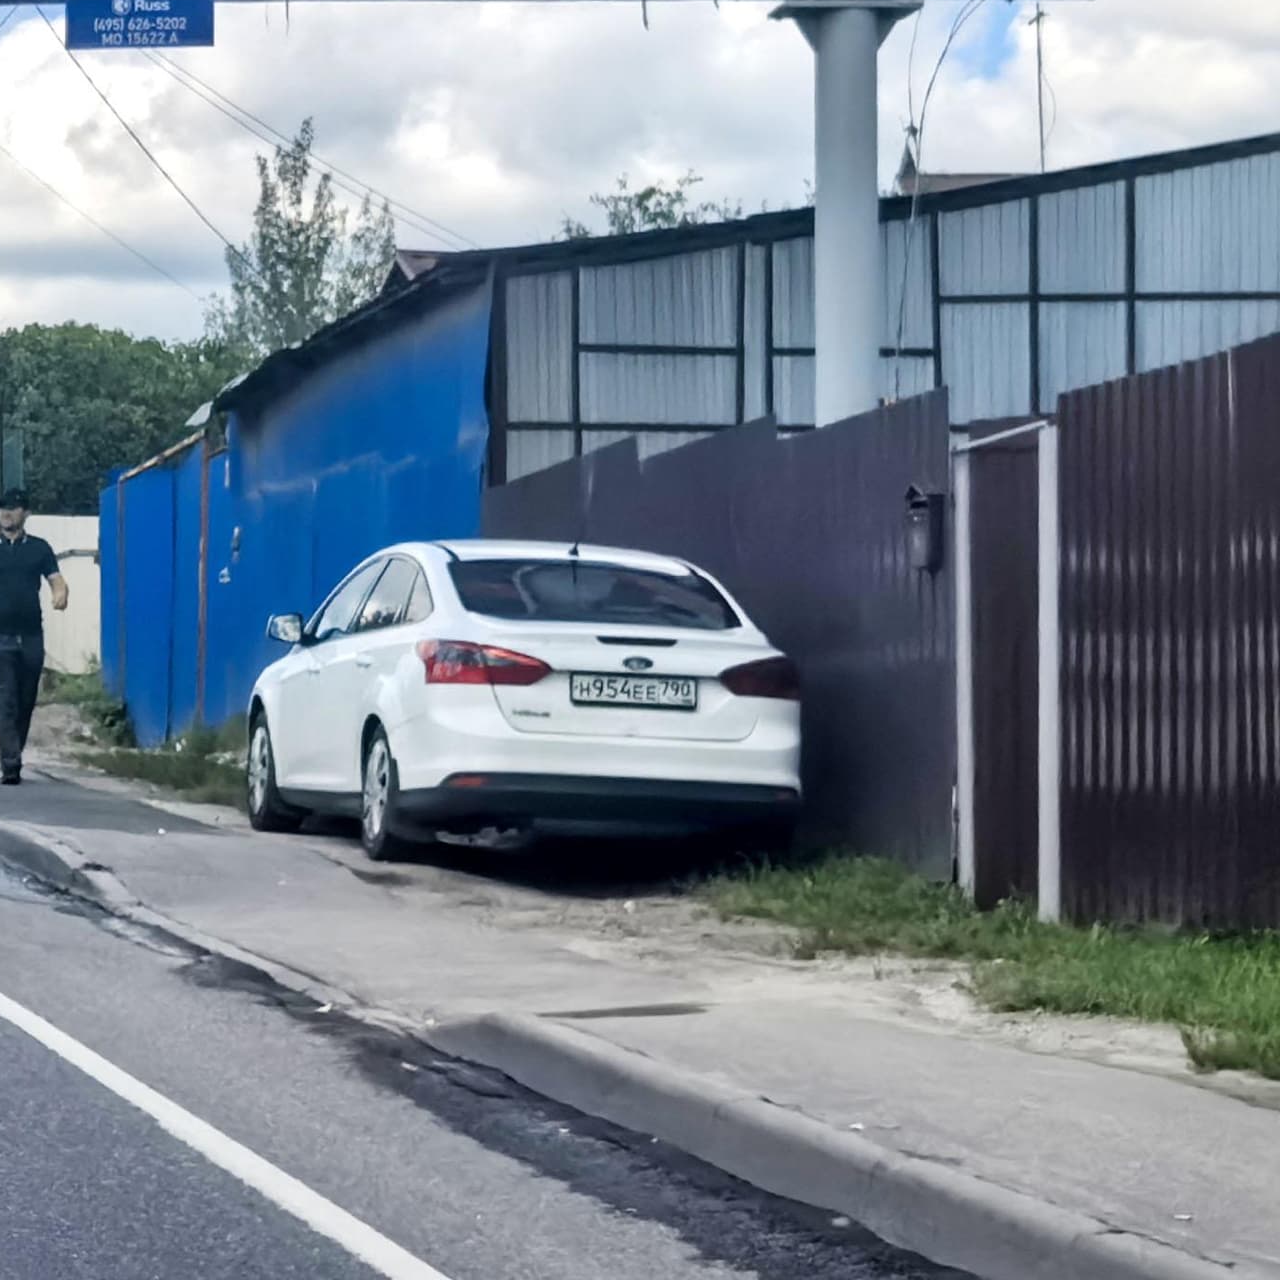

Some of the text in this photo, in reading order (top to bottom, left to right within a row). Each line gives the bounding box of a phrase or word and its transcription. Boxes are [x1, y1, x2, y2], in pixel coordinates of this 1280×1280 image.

[134, 0, 170, 11] Russ
[94, 17, 187, 32] (495) 626-5202
[579, 678, 690, 701] Н954ЕЕ 790
